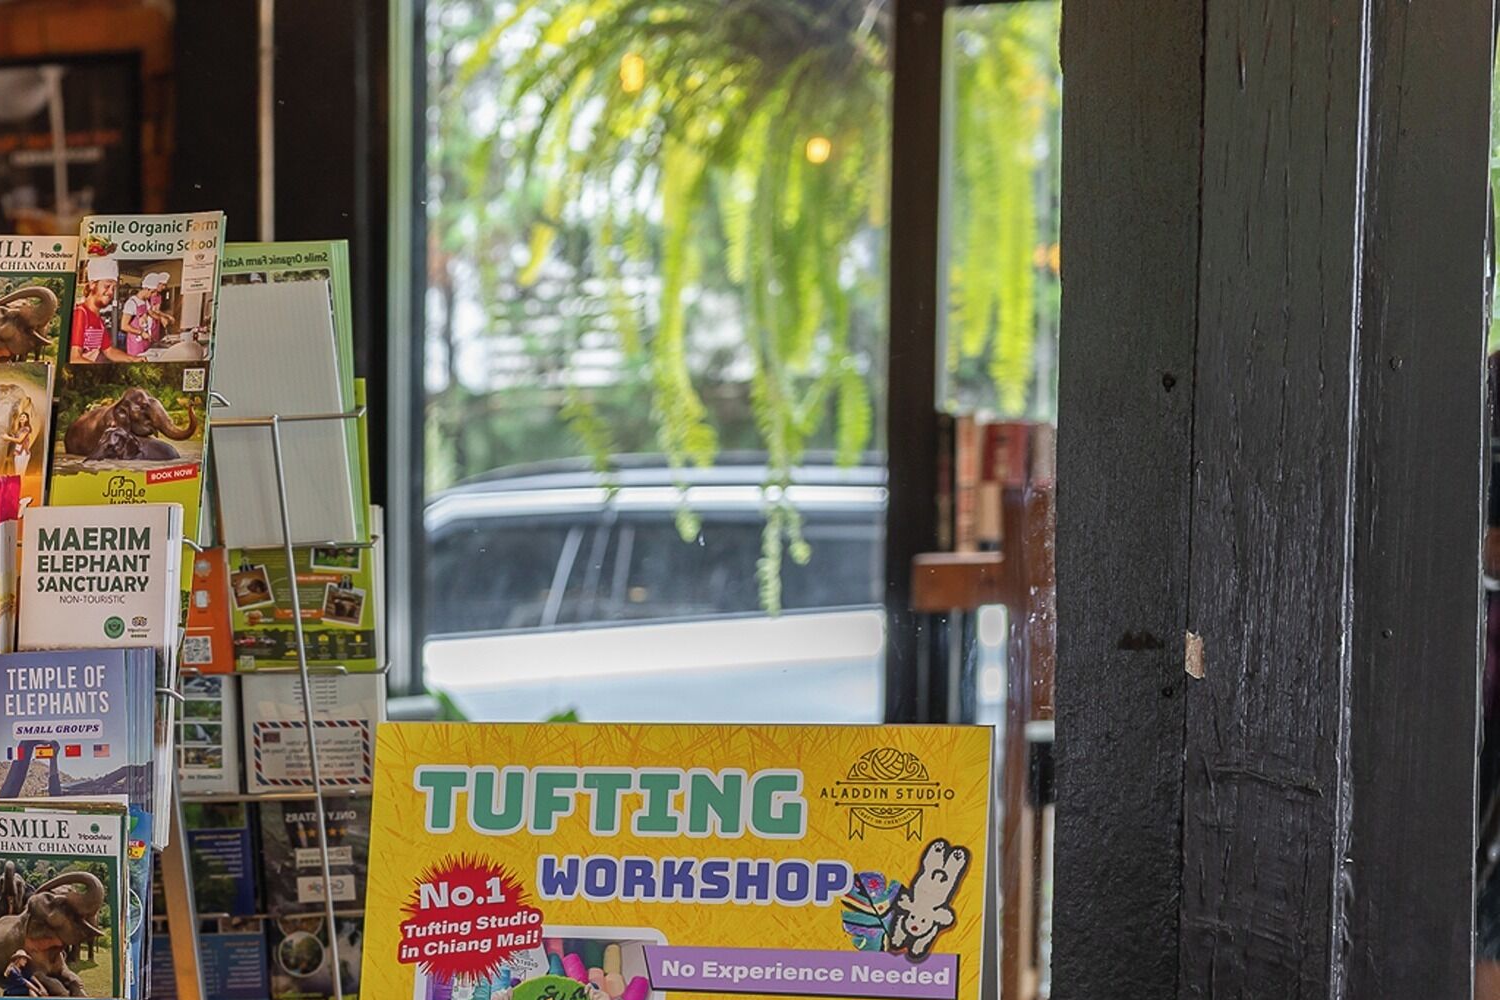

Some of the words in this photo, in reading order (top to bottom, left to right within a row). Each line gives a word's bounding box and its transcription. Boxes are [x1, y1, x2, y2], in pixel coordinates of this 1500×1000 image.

[88, 222, 125, 235] Smile
[128, 220, 183, 237] Organic
[186, 220, 218, 232] Farm
[121, 240, 174, 254] Cooking
[177, 236, 217, 251] School
[0, 261, 67, 271] CHIANGMAI
[150, 471, 171, 481] BOOK
[173, 468, 193, 477] NOW
[102, 481, 146, 498] Jungle
[38, 527, 151, 551] MAERIM
[37, 554, 151, 572] ELEPHANT
[37, 576, 149, 592] SANCTUARY
[59, 595, 126, 604] NON-TOURISTIC
[7, 667, 79, 690] TEMPLE
[85, 666, 106, 688] OF
[5, 691, 109, 716] ELEPHANTS
[16, 725, 54, 734] SMALL
[56, 724, 100, 734] GROUPS
[413, 765, 806, 838] TUFTING
[820, 788, 888, 799] ALADDIN
[896, 788, 955, 800] STUDIO
[38, 842, 107, 854] CHIANGMAI
[538, 855, 852, 904] WORKSHOP
[419, 876, 505, 910] No.1
[403, 918, 473, 940] Tufting
[475, 910, 541, 931] Studio
[401, 944, 421, 959] in
[424, 936, 494, 959] Chiang
[497, 930, 539, 949] Mai!
[661, 959, 695, 977] No
[702, 961, 844, 982] Experience
[851, 966, 950, 986] Needed
